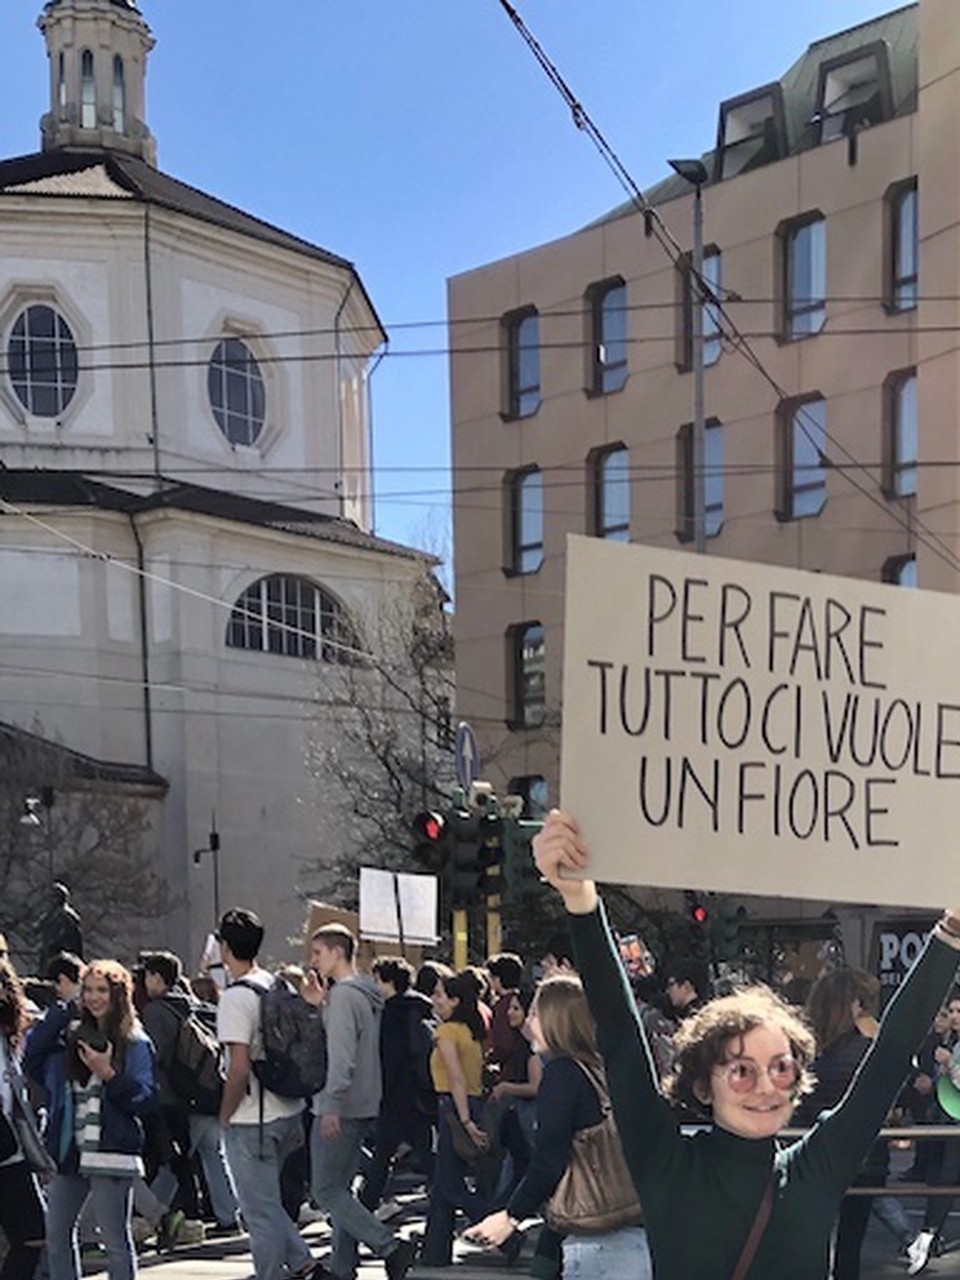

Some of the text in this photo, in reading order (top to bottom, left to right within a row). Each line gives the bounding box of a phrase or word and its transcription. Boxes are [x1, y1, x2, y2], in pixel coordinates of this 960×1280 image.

[648, 574, 887, 690] PER FARE
[587, 660, 752, 749] TUTTO
[761, 683, 801, 759] CI
[639, 756, 899, 850] UN FIORE
